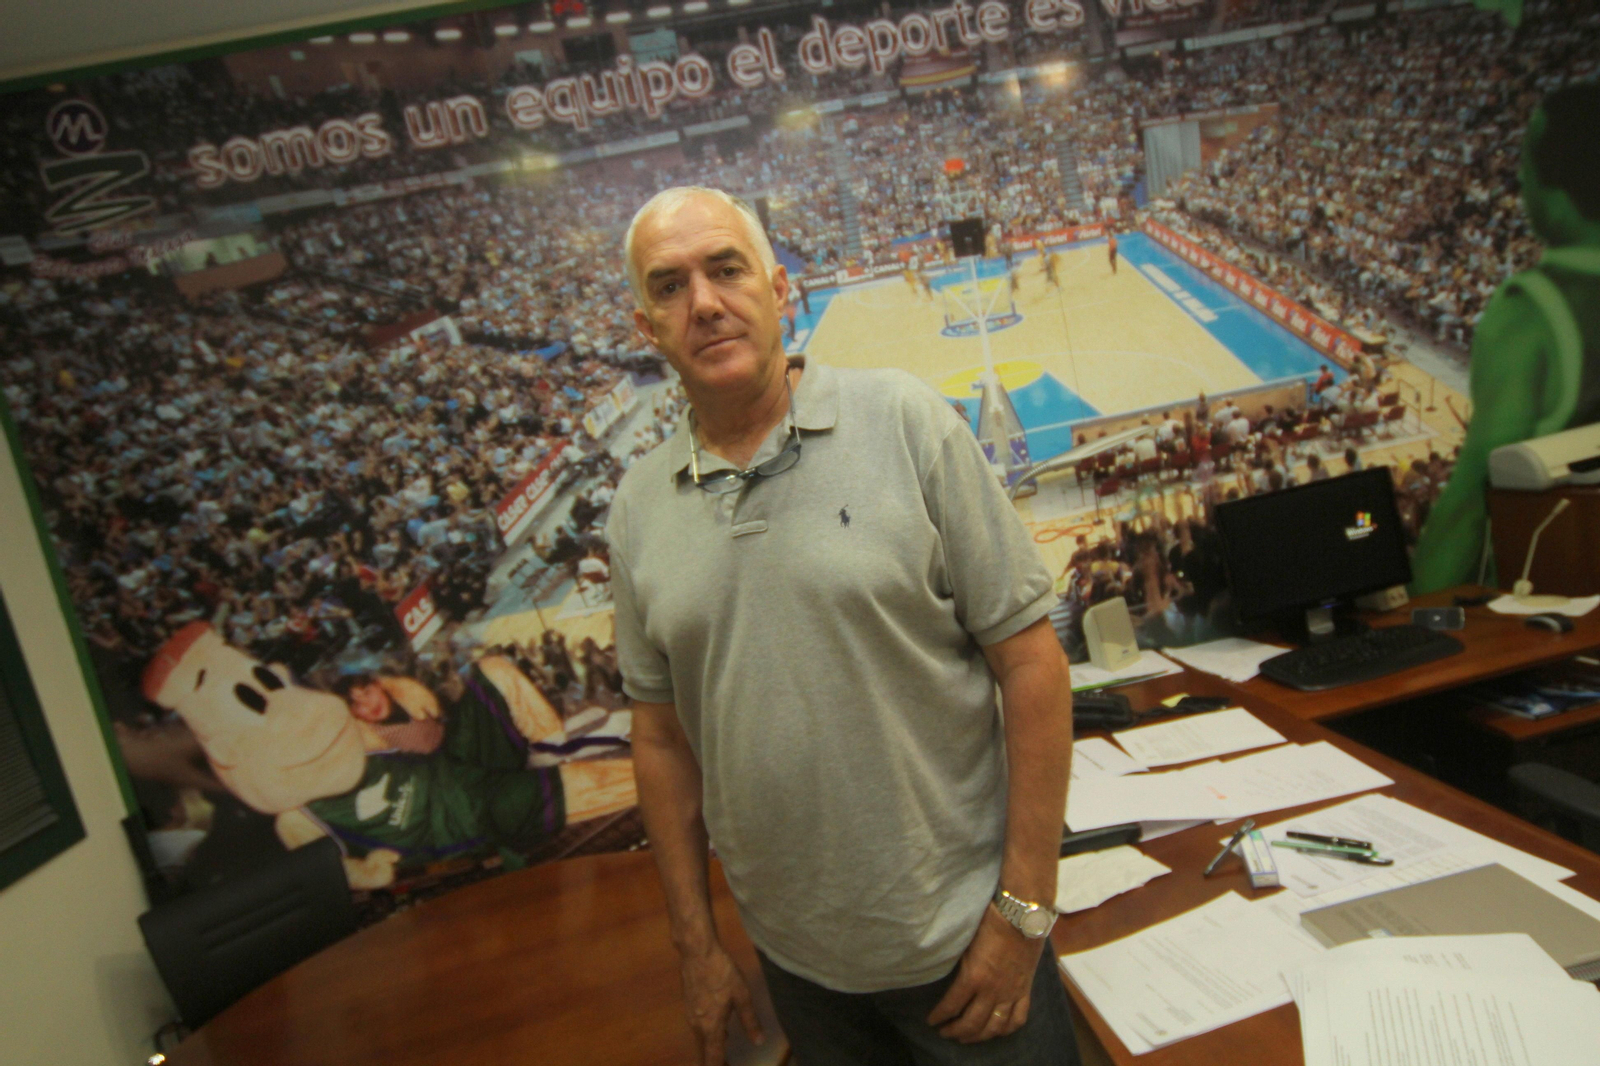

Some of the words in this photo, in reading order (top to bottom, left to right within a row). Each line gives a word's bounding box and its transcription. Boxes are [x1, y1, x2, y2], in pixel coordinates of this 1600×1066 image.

[187, 112, 391, 188] somos
[403, 95, 488, 147] un
[505, 54, 713, 131] equipo
[726, 27, 786, 87] el
[798, 0, 1010, 75] deporte
[1024, 0, 1085, 33] es
